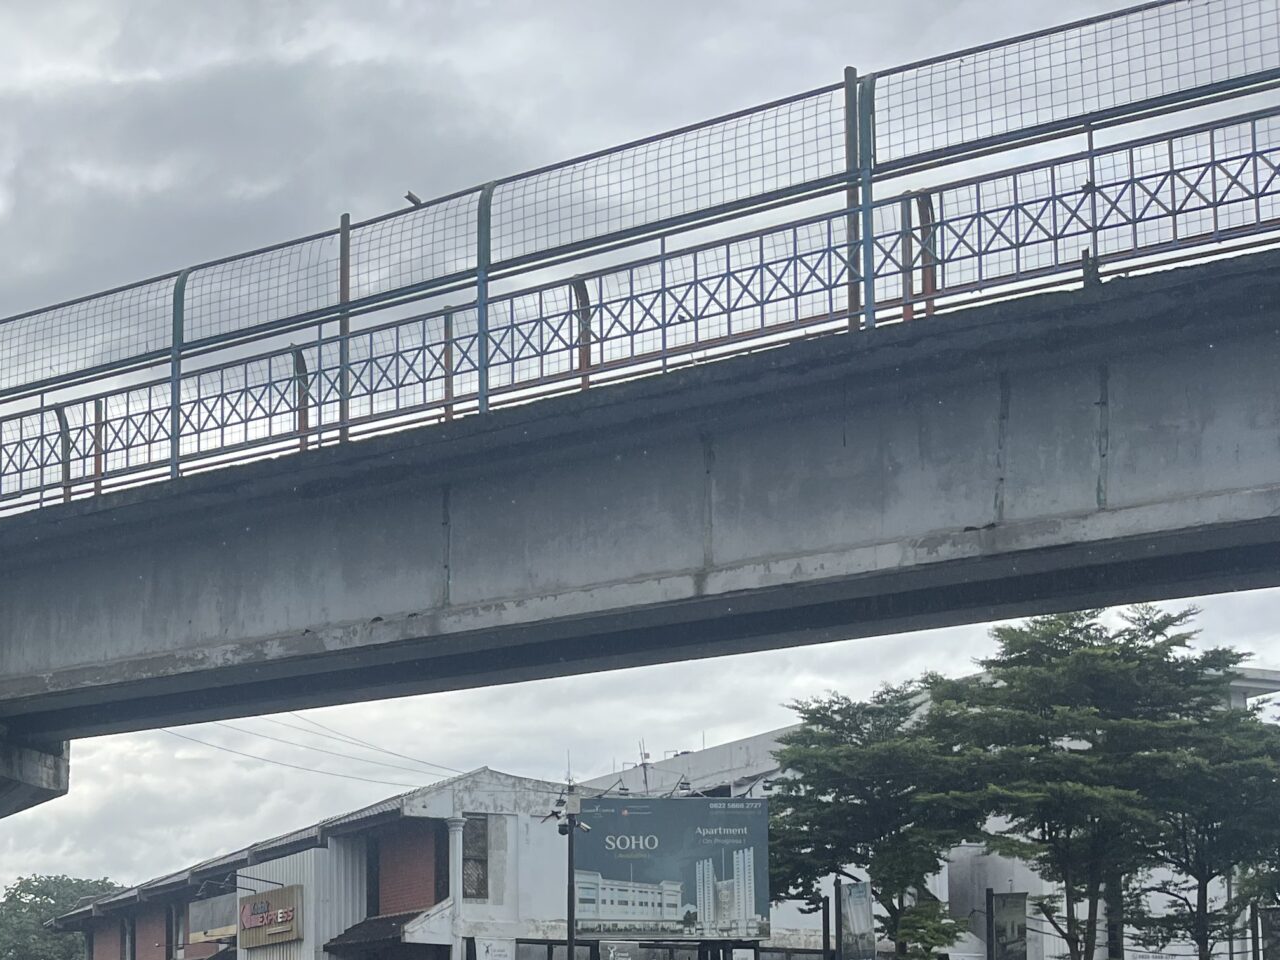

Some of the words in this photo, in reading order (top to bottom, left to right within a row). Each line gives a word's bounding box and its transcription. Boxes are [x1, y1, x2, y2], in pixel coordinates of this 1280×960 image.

[695, 826, 748, 835] Apartment
[605, 834, 659, 850] SOHO
[259, 907, 295, 926] EXPRESS
